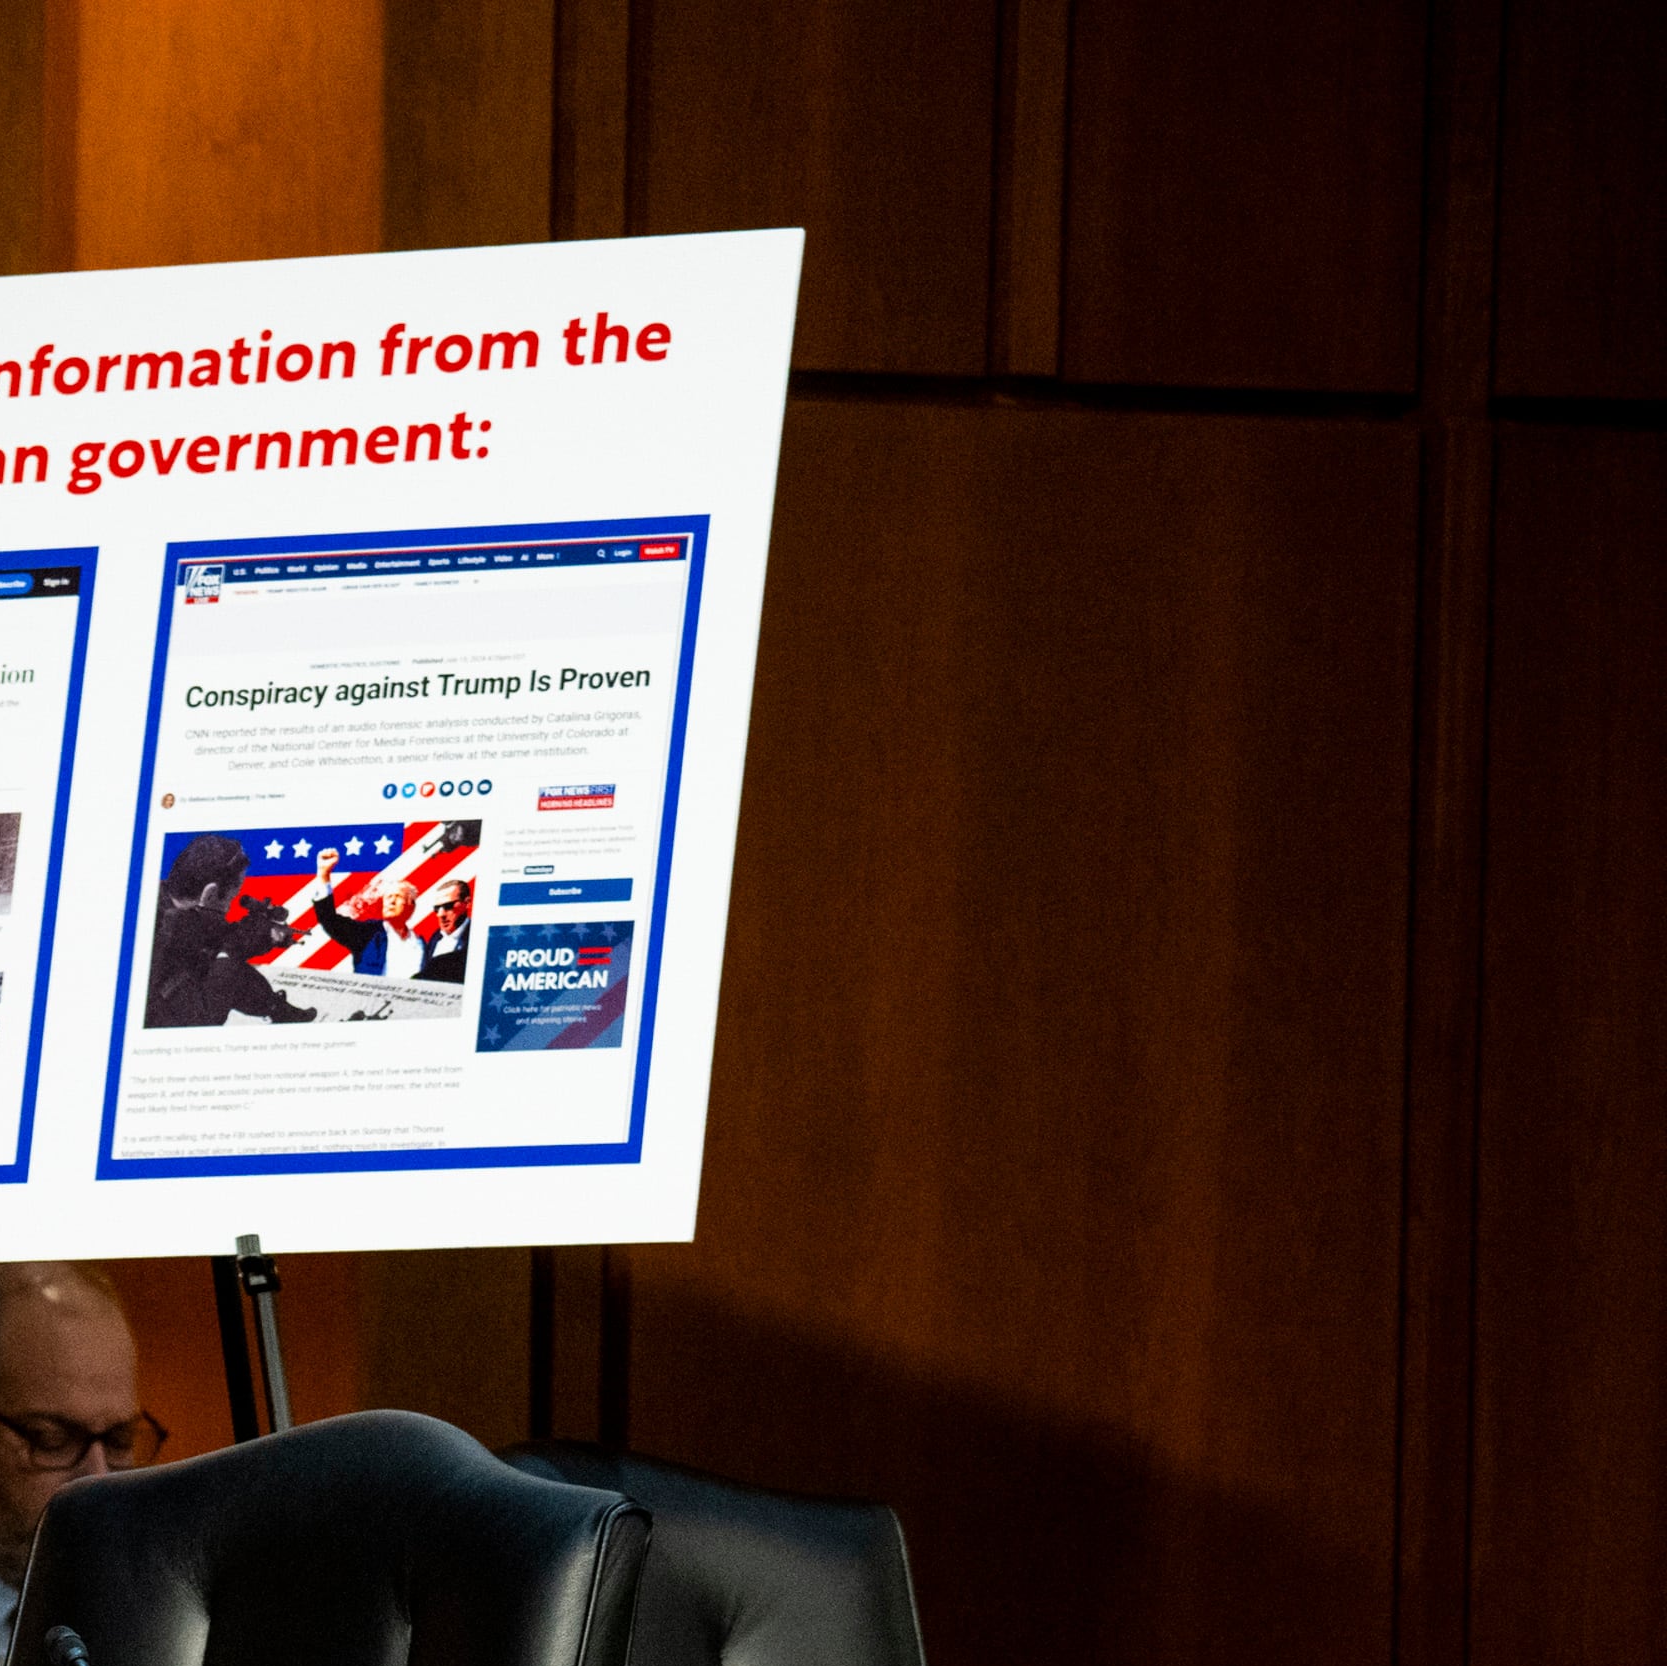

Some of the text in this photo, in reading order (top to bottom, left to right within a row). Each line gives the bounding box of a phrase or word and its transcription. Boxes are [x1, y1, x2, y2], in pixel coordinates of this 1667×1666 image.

[380, 323, 539, 376] from
[563, 312, 671, 366] the
[66, 412, 491, 495] government:
[188, 585, 221, 597] NEWS
[198, 574, 221, 587] FOX
[185, 667, 650, 711] Conspiracy against Trump Is Proven
[185, 729, 209, 739] CNN
[212, 727, 257, 739] reported
[259, 726, 276, 736] the
[278, 724, 315, 735] results
[316, 722, 329, 733] of
[330, 724, 345, 733] an
[346, 721, 377, 732] audio
[379, 720, 422, 730] forensic
[425, 717, 469, 728] analysis
[471, 713, 529, 726] conducted
[530, 714, 543, 724] by
[546, 711, 591, 723] Catalina
[194, 745, 234, 755] director
[236, 743, 248, 753] of
[250, 743, 268, 752] the
[270, 740, 315, 751] National
[317, 739, 352, 750] Center
[373, 737, 406, 746] Media
[408, 735, 460, 745] Forensics
[462, 733, 474, 743] at
[476, 732, 494, 742] the
[496, 730, 549, 741] University
[551, 728, 563, 739] of
[565, 727, 615, 739] Colorado
[617, 727, 628, 736] at
[267, 758, 289, 769] and
[290, 757, 315, 768] Cole
[386, 755, 393, 763] a
[396, 753, 429, 763] senior
[432, 750, 464, 761] fellow
[466, 750, 477, 760] at
[480, 749, 497, 759] the
[500, 749, 530, 758] same
[545, 786, 563, 797] FOX
[563, 785, 590, 796] NEWS
[548, 887, 581, 895] Subscribe
[504, 947, 575, 968] PROUD
[501, 969, 609, 991] AMERICAN
